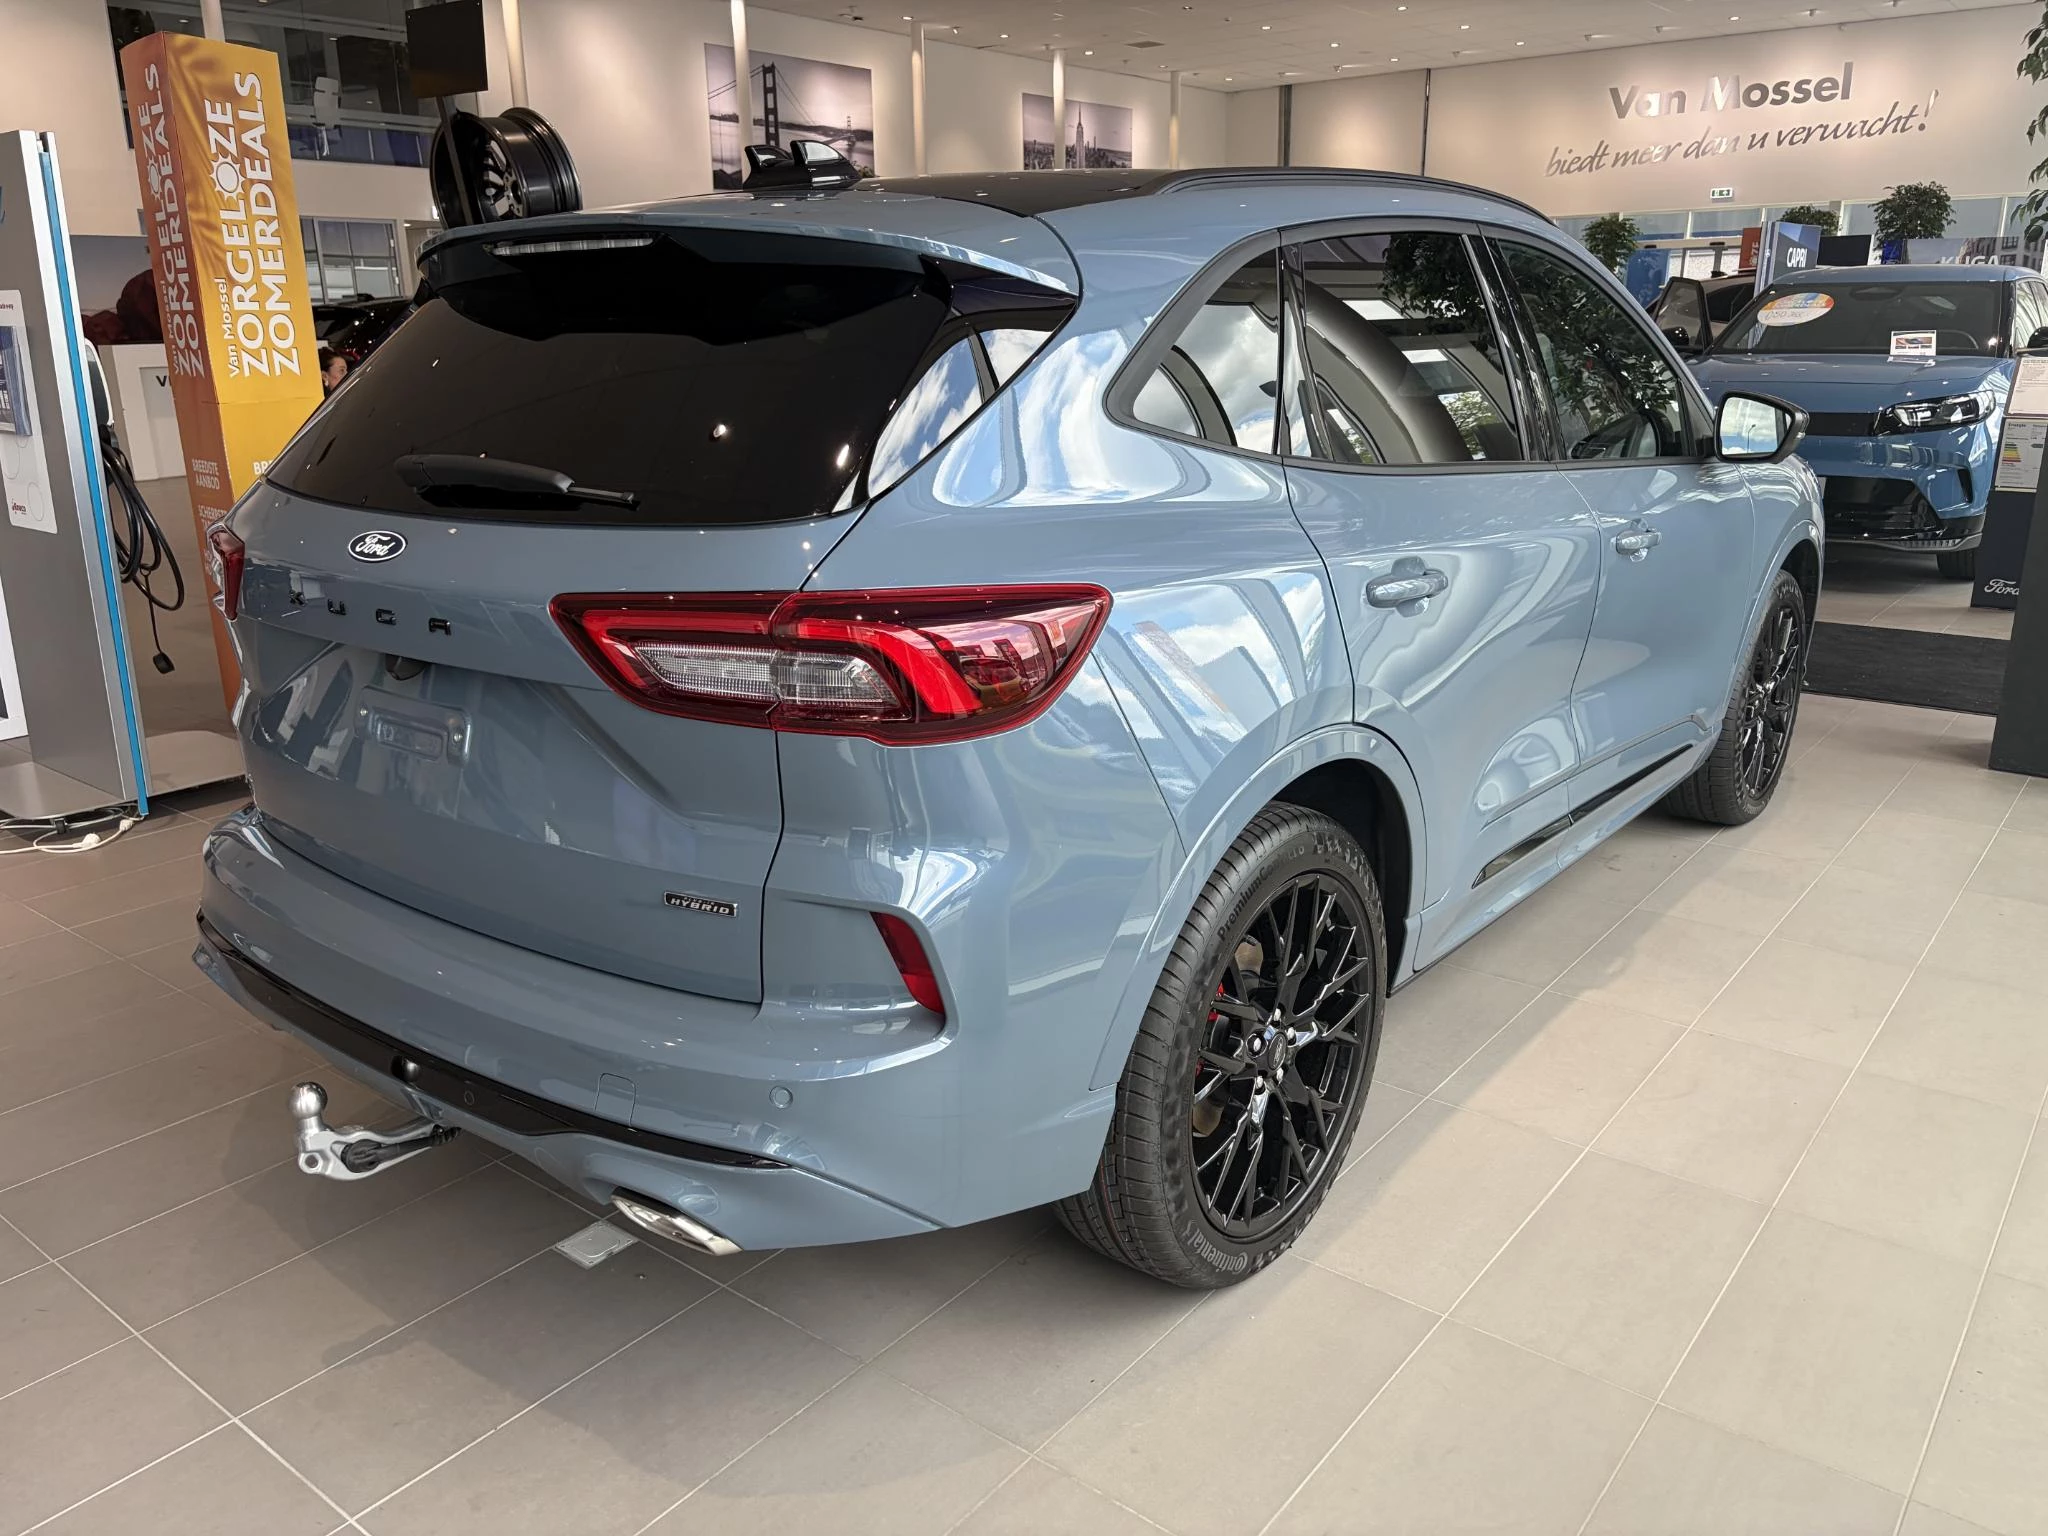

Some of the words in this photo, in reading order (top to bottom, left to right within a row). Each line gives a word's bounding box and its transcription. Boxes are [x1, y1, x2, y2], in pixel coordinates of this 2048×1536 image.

[1609, 84, 1686, 120] Van
[1700, 61, 1854, 112] Mossel
[1545, 140, 1607, 177] biedt
[1611, 141, 1682, 168] meer
[1682, 126, 1739, 160] dan
[1748, 131, 1769, 150] u
[1776, 89, 1939, 147] verwacht!
[145, 63, 205, 378] ZOMERDEALS
[234, 71, 301, 377] ZOMERDEALS
[1786, 247, 1808, 268] CAPRI
[213, 278, 234, 341] Mossel
[228, 343, 241, 378] Van
[354, 533, 396, 557] Ford
[670, 897, 730, 915] HYBRID
